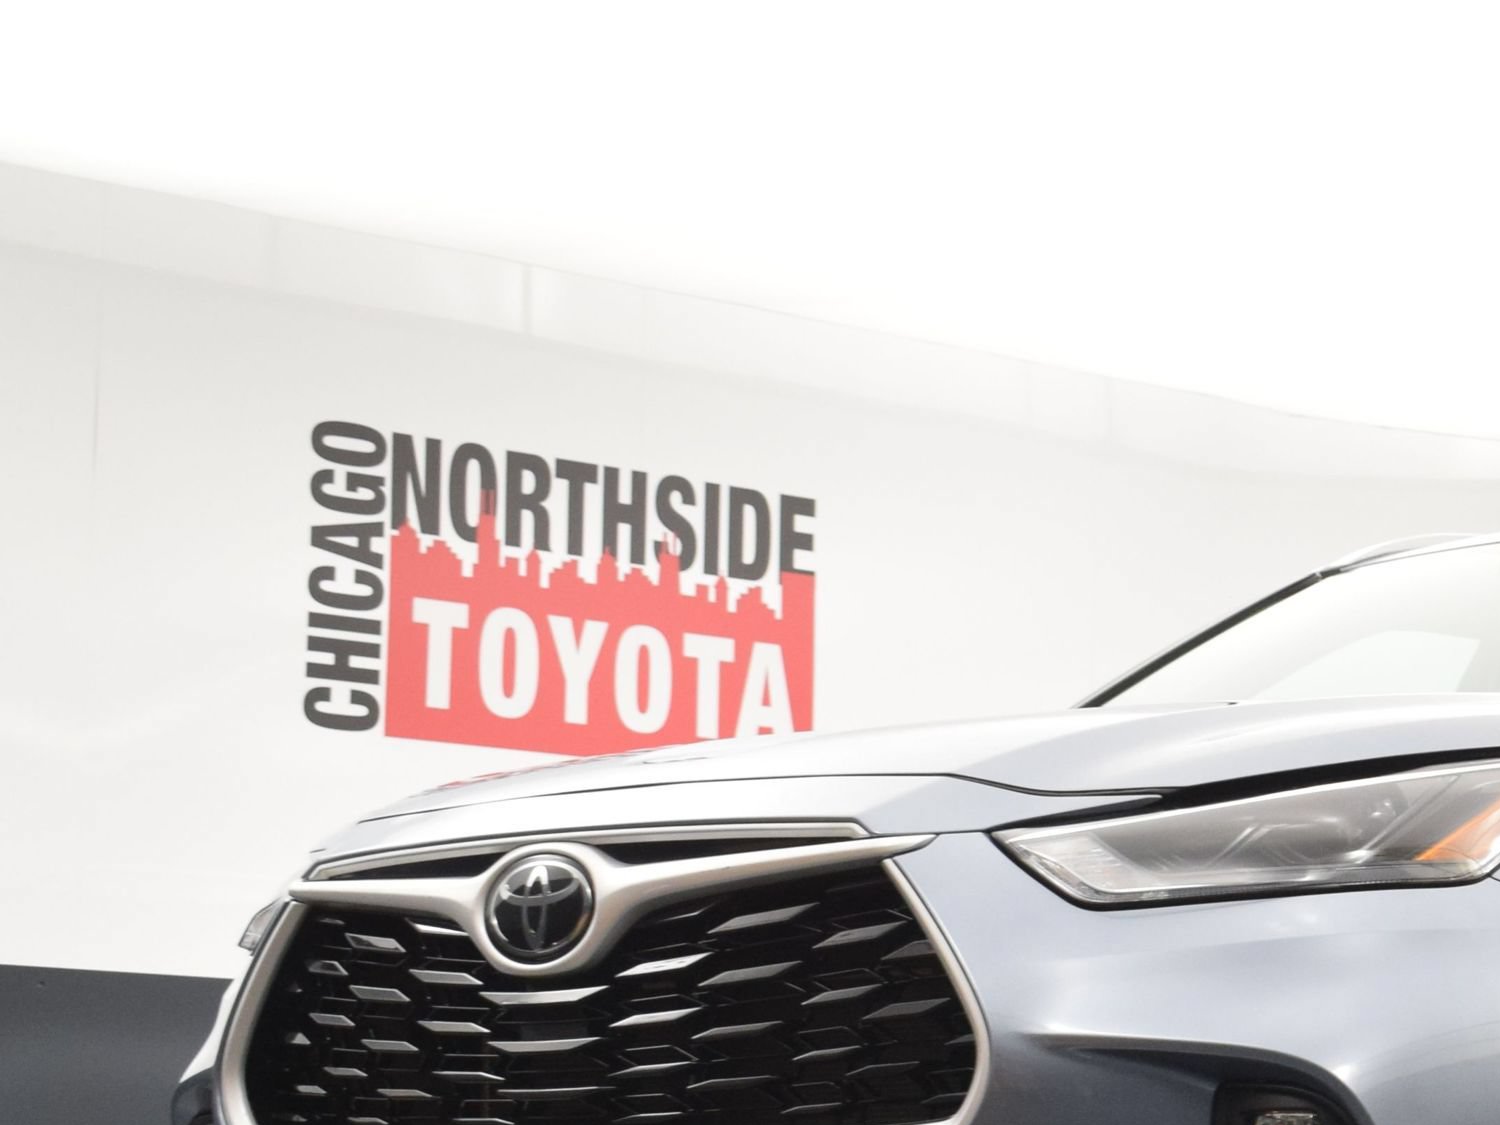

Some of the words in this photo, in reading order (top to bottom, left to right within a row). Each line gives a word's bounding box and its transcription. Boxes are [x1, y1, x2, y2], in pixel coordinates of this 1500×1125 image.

[304, 420, 387, 732] CHICAGO
[392, 431, 816, 581] NORTHSIDE
[411, 596, 795, 740] TOYOTA
